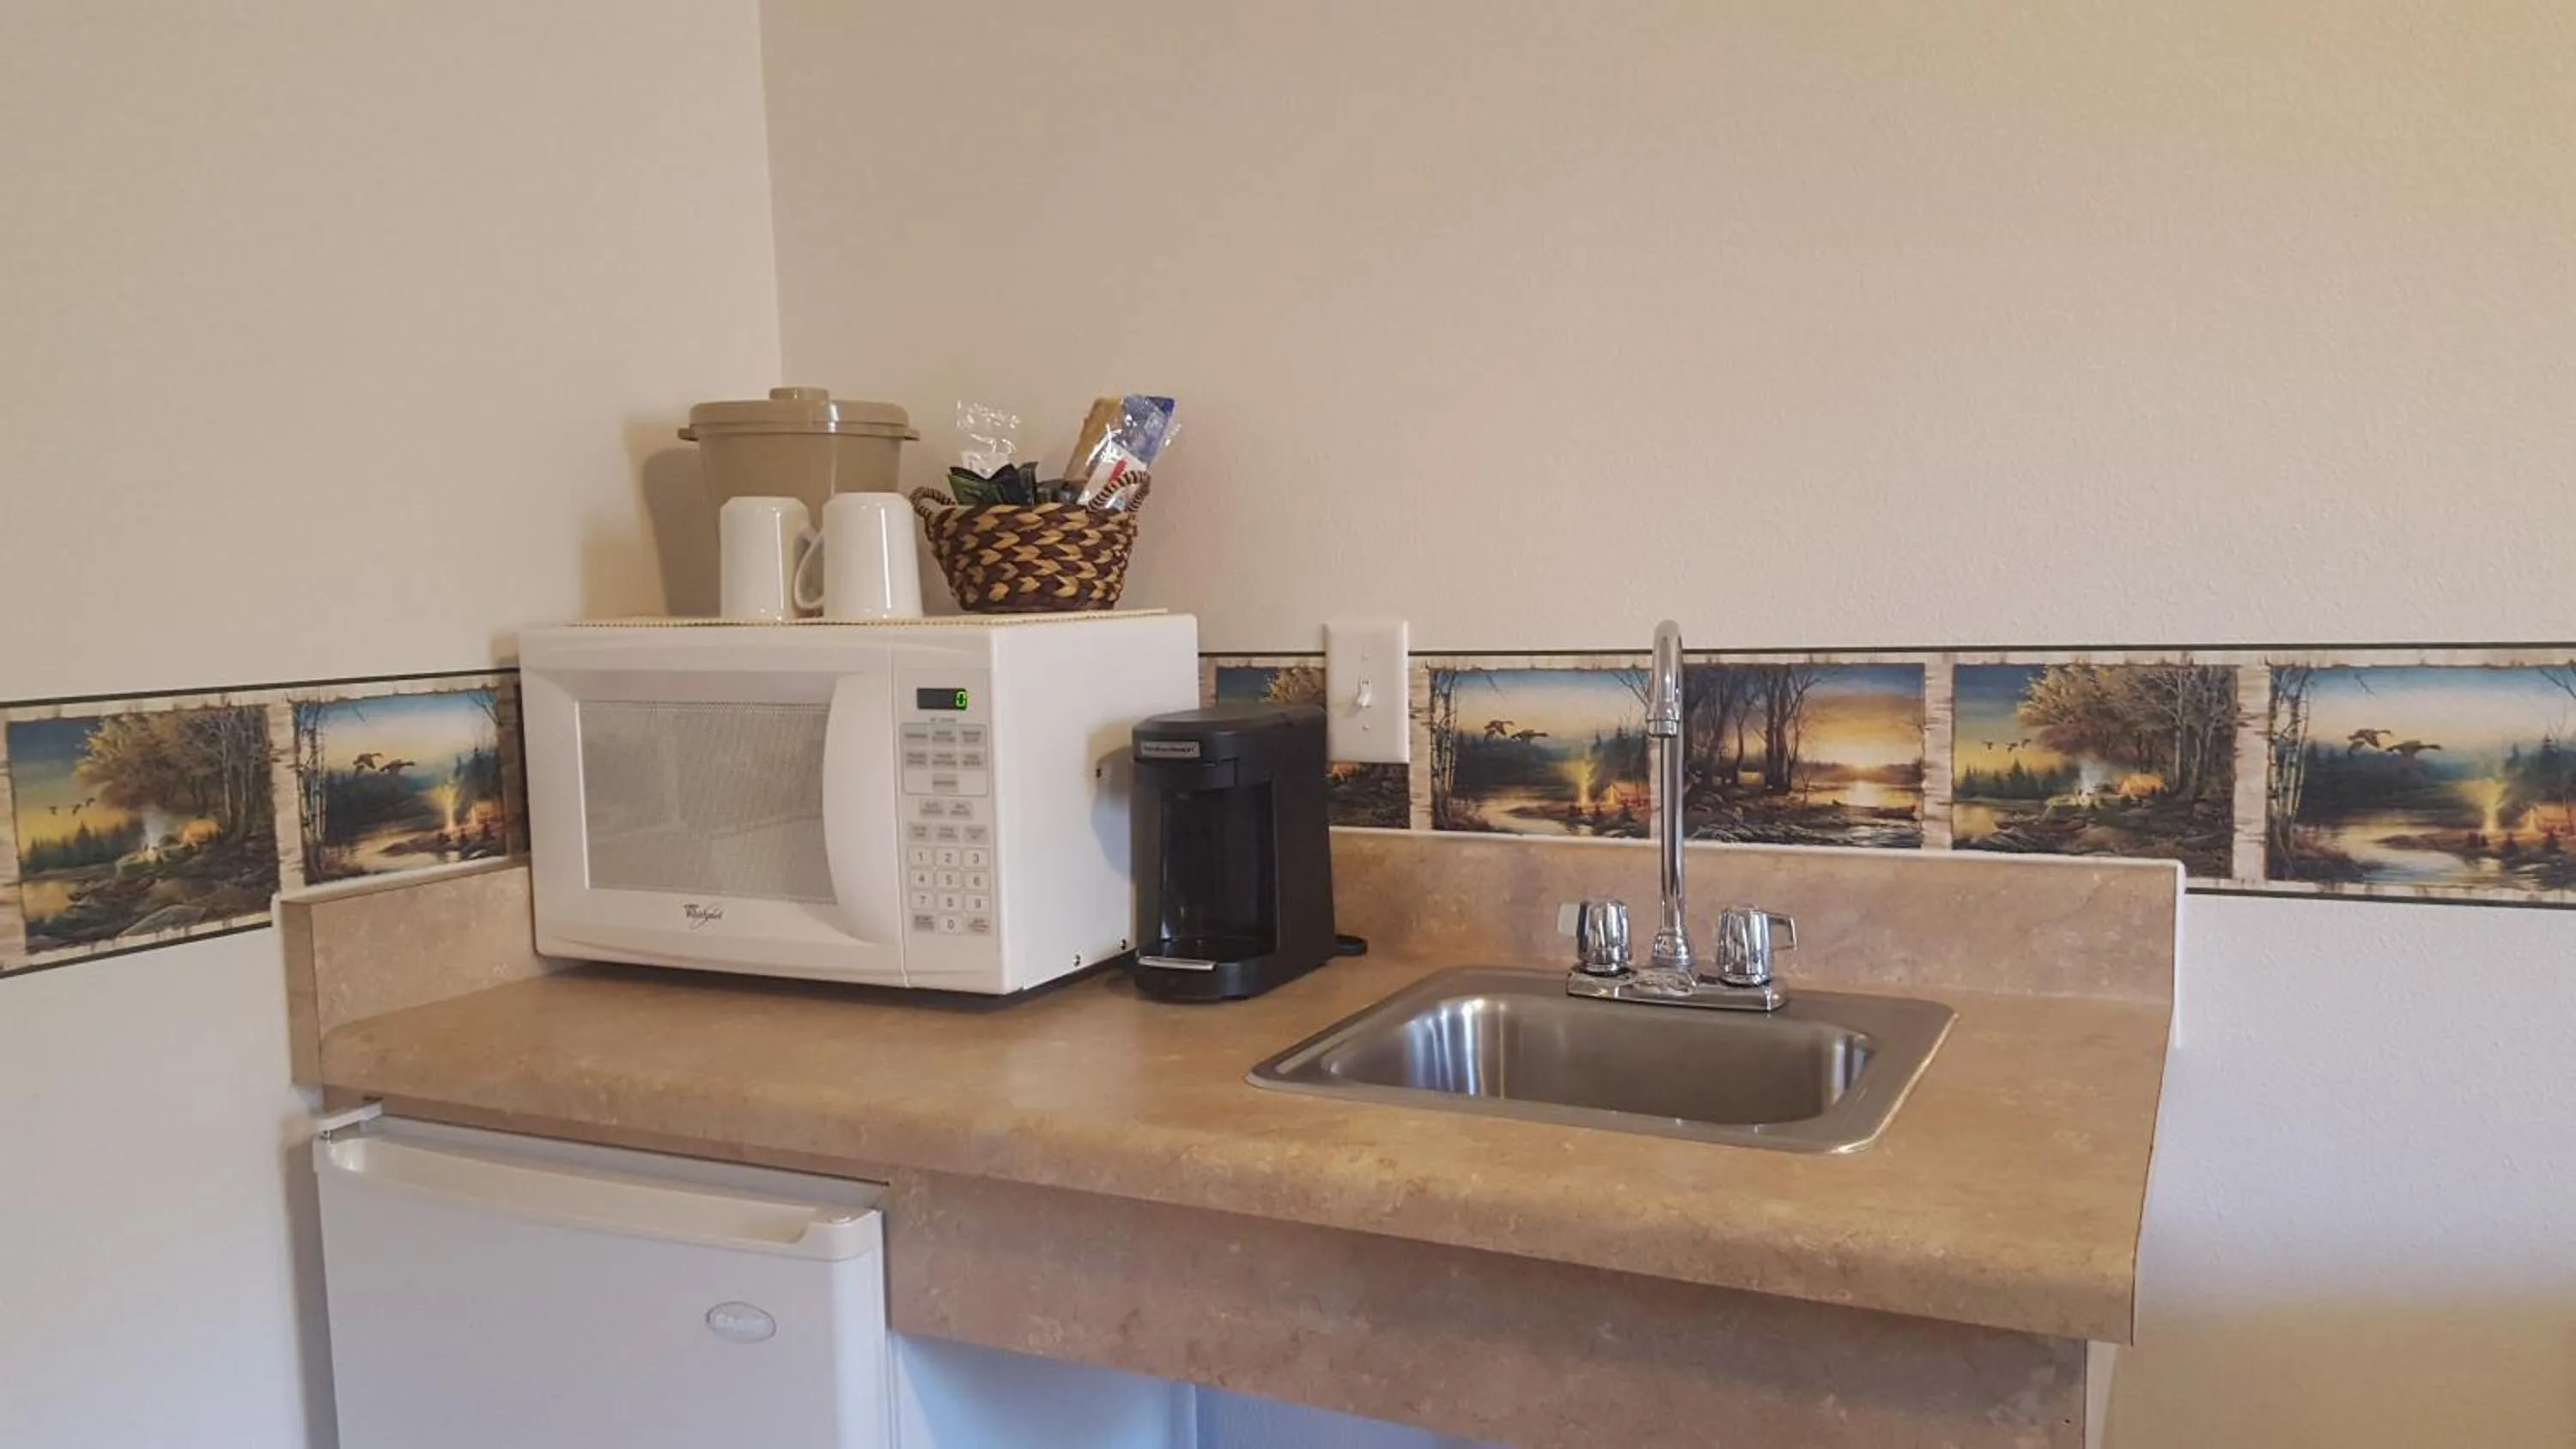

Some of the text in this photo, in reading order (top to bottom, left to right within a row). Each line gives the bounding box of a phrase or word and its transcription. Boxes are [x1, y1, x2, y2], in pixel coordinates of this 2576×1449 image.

[956, 691, 966, 707] 0
[917, 851, 980, 864] 1 2 3
[918, 873, 981, 887] 4 5 6
[947, 919, 955, 930] 0
